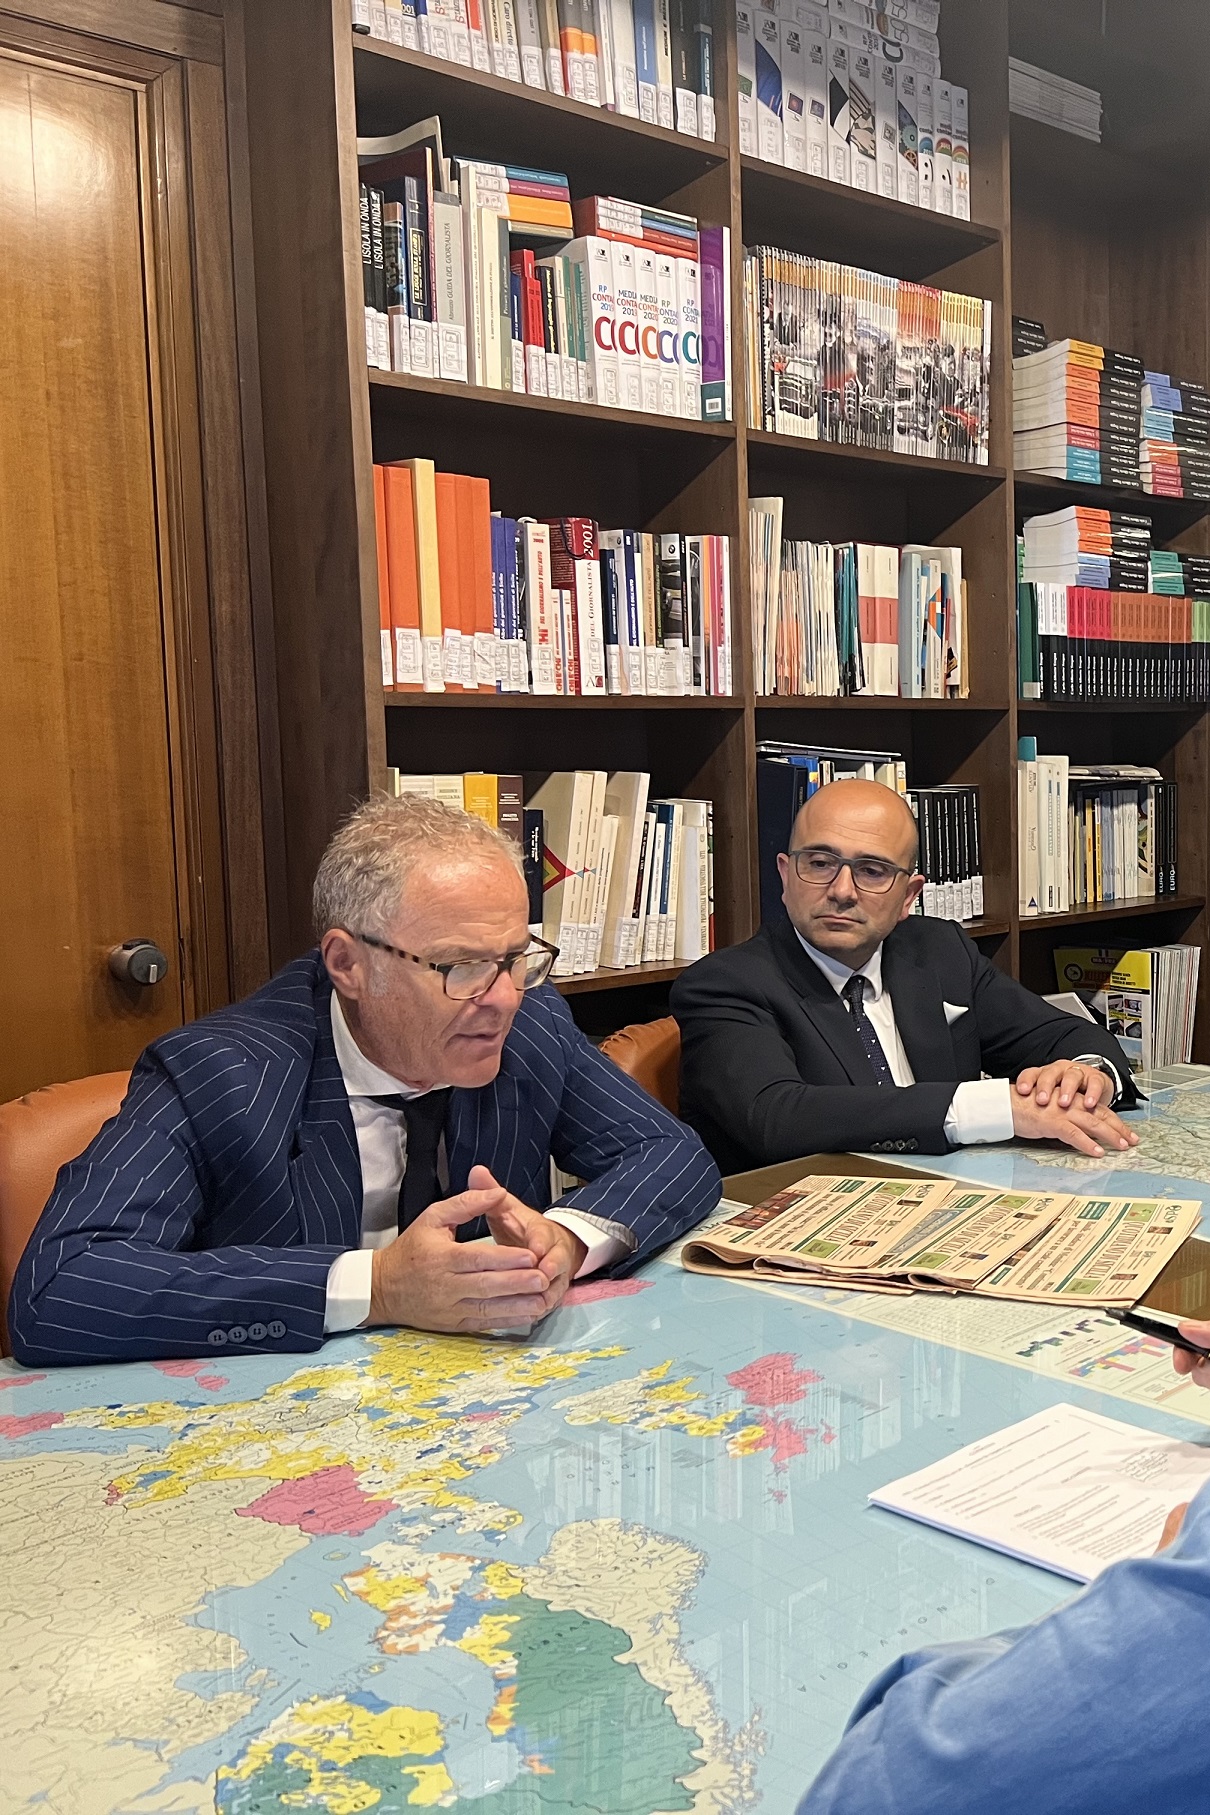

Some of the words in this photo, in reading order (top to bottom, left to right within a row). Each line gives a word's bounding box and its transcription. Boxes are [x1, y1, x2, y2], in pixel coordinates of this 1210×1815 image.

[359, 197, 369, 221] ONDA
[371, 203, 382, 227] ONDA
[361, 223, 370, 232] IN
[444, 222, 452, 264] GIORNALISTA
[598, 285, 607, 293] RP
[661, 300, 670, 308] RP
[686, 298, 694, 307] RP
[537, 582, 545, 614] GIORNALISMO
[585, 561, 595, 619] GIORNALISTA
